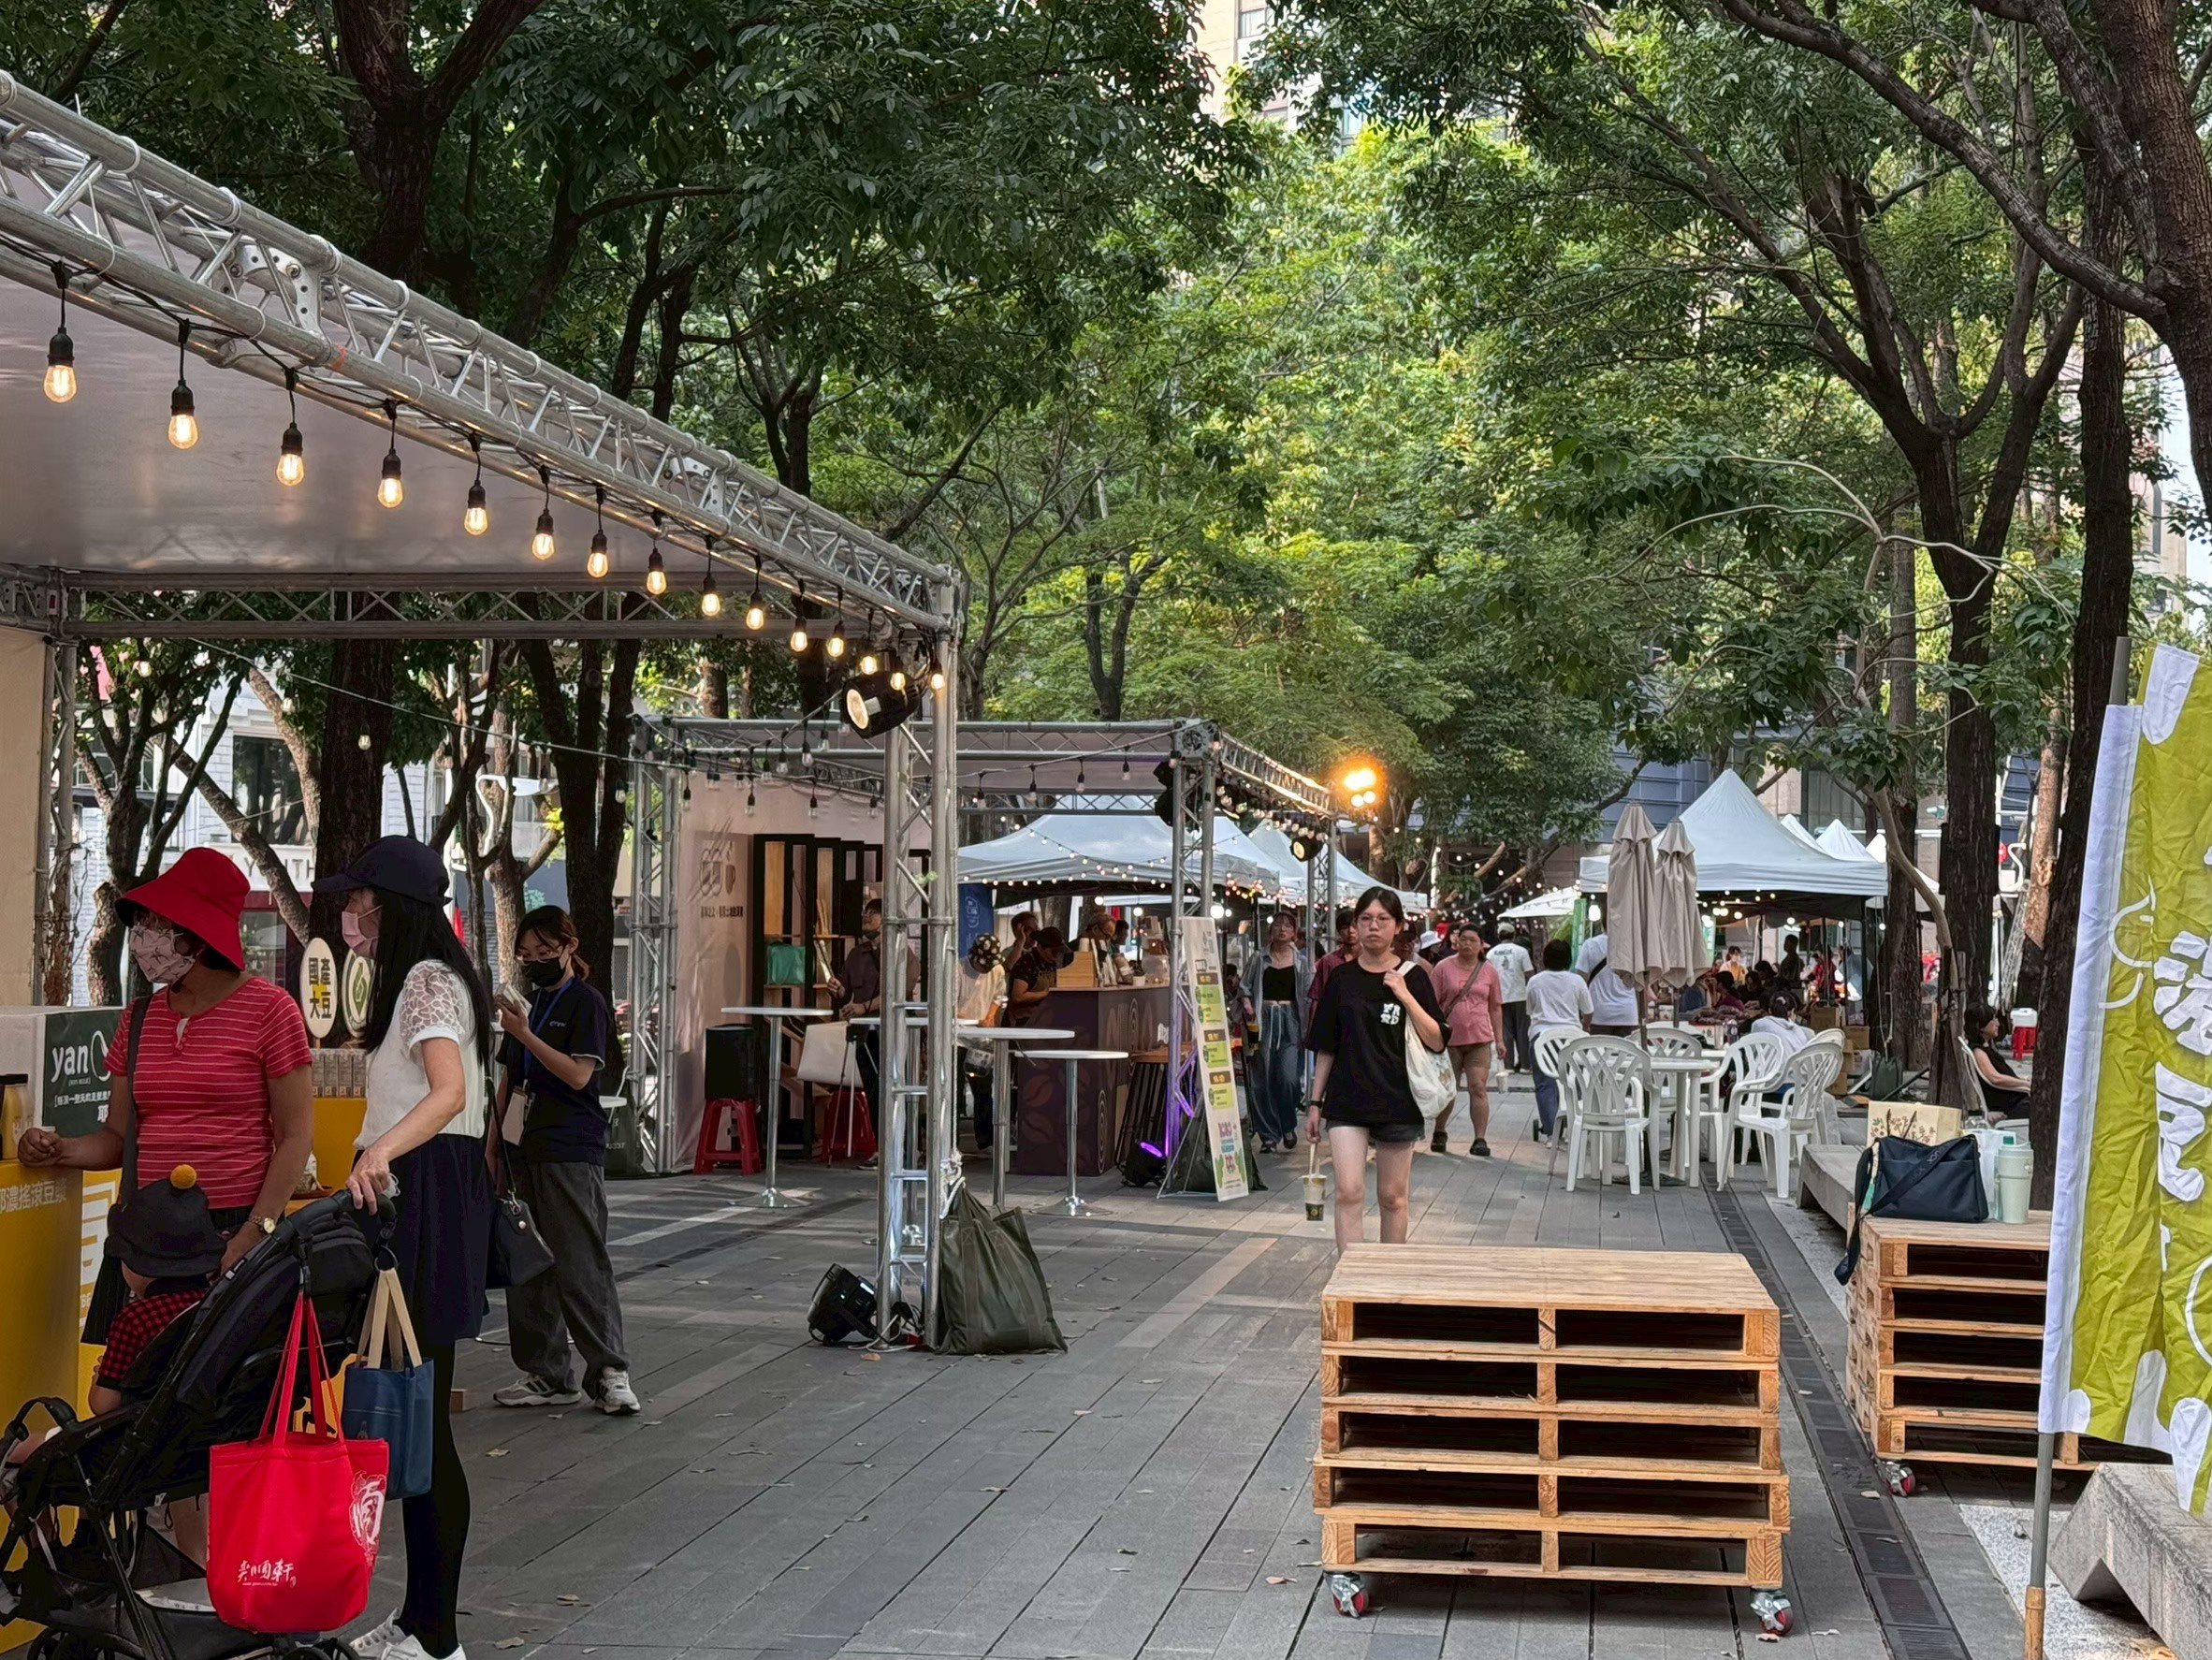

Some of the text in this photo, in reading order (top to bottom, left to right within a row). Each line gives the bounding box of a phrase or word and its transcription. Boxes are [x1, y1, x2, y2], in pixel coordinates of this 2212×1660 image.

[243, 856, 316, 881] YTH
[308, 957, 331, 985] 國產
[310, 991, 332, 1019] 大豆
